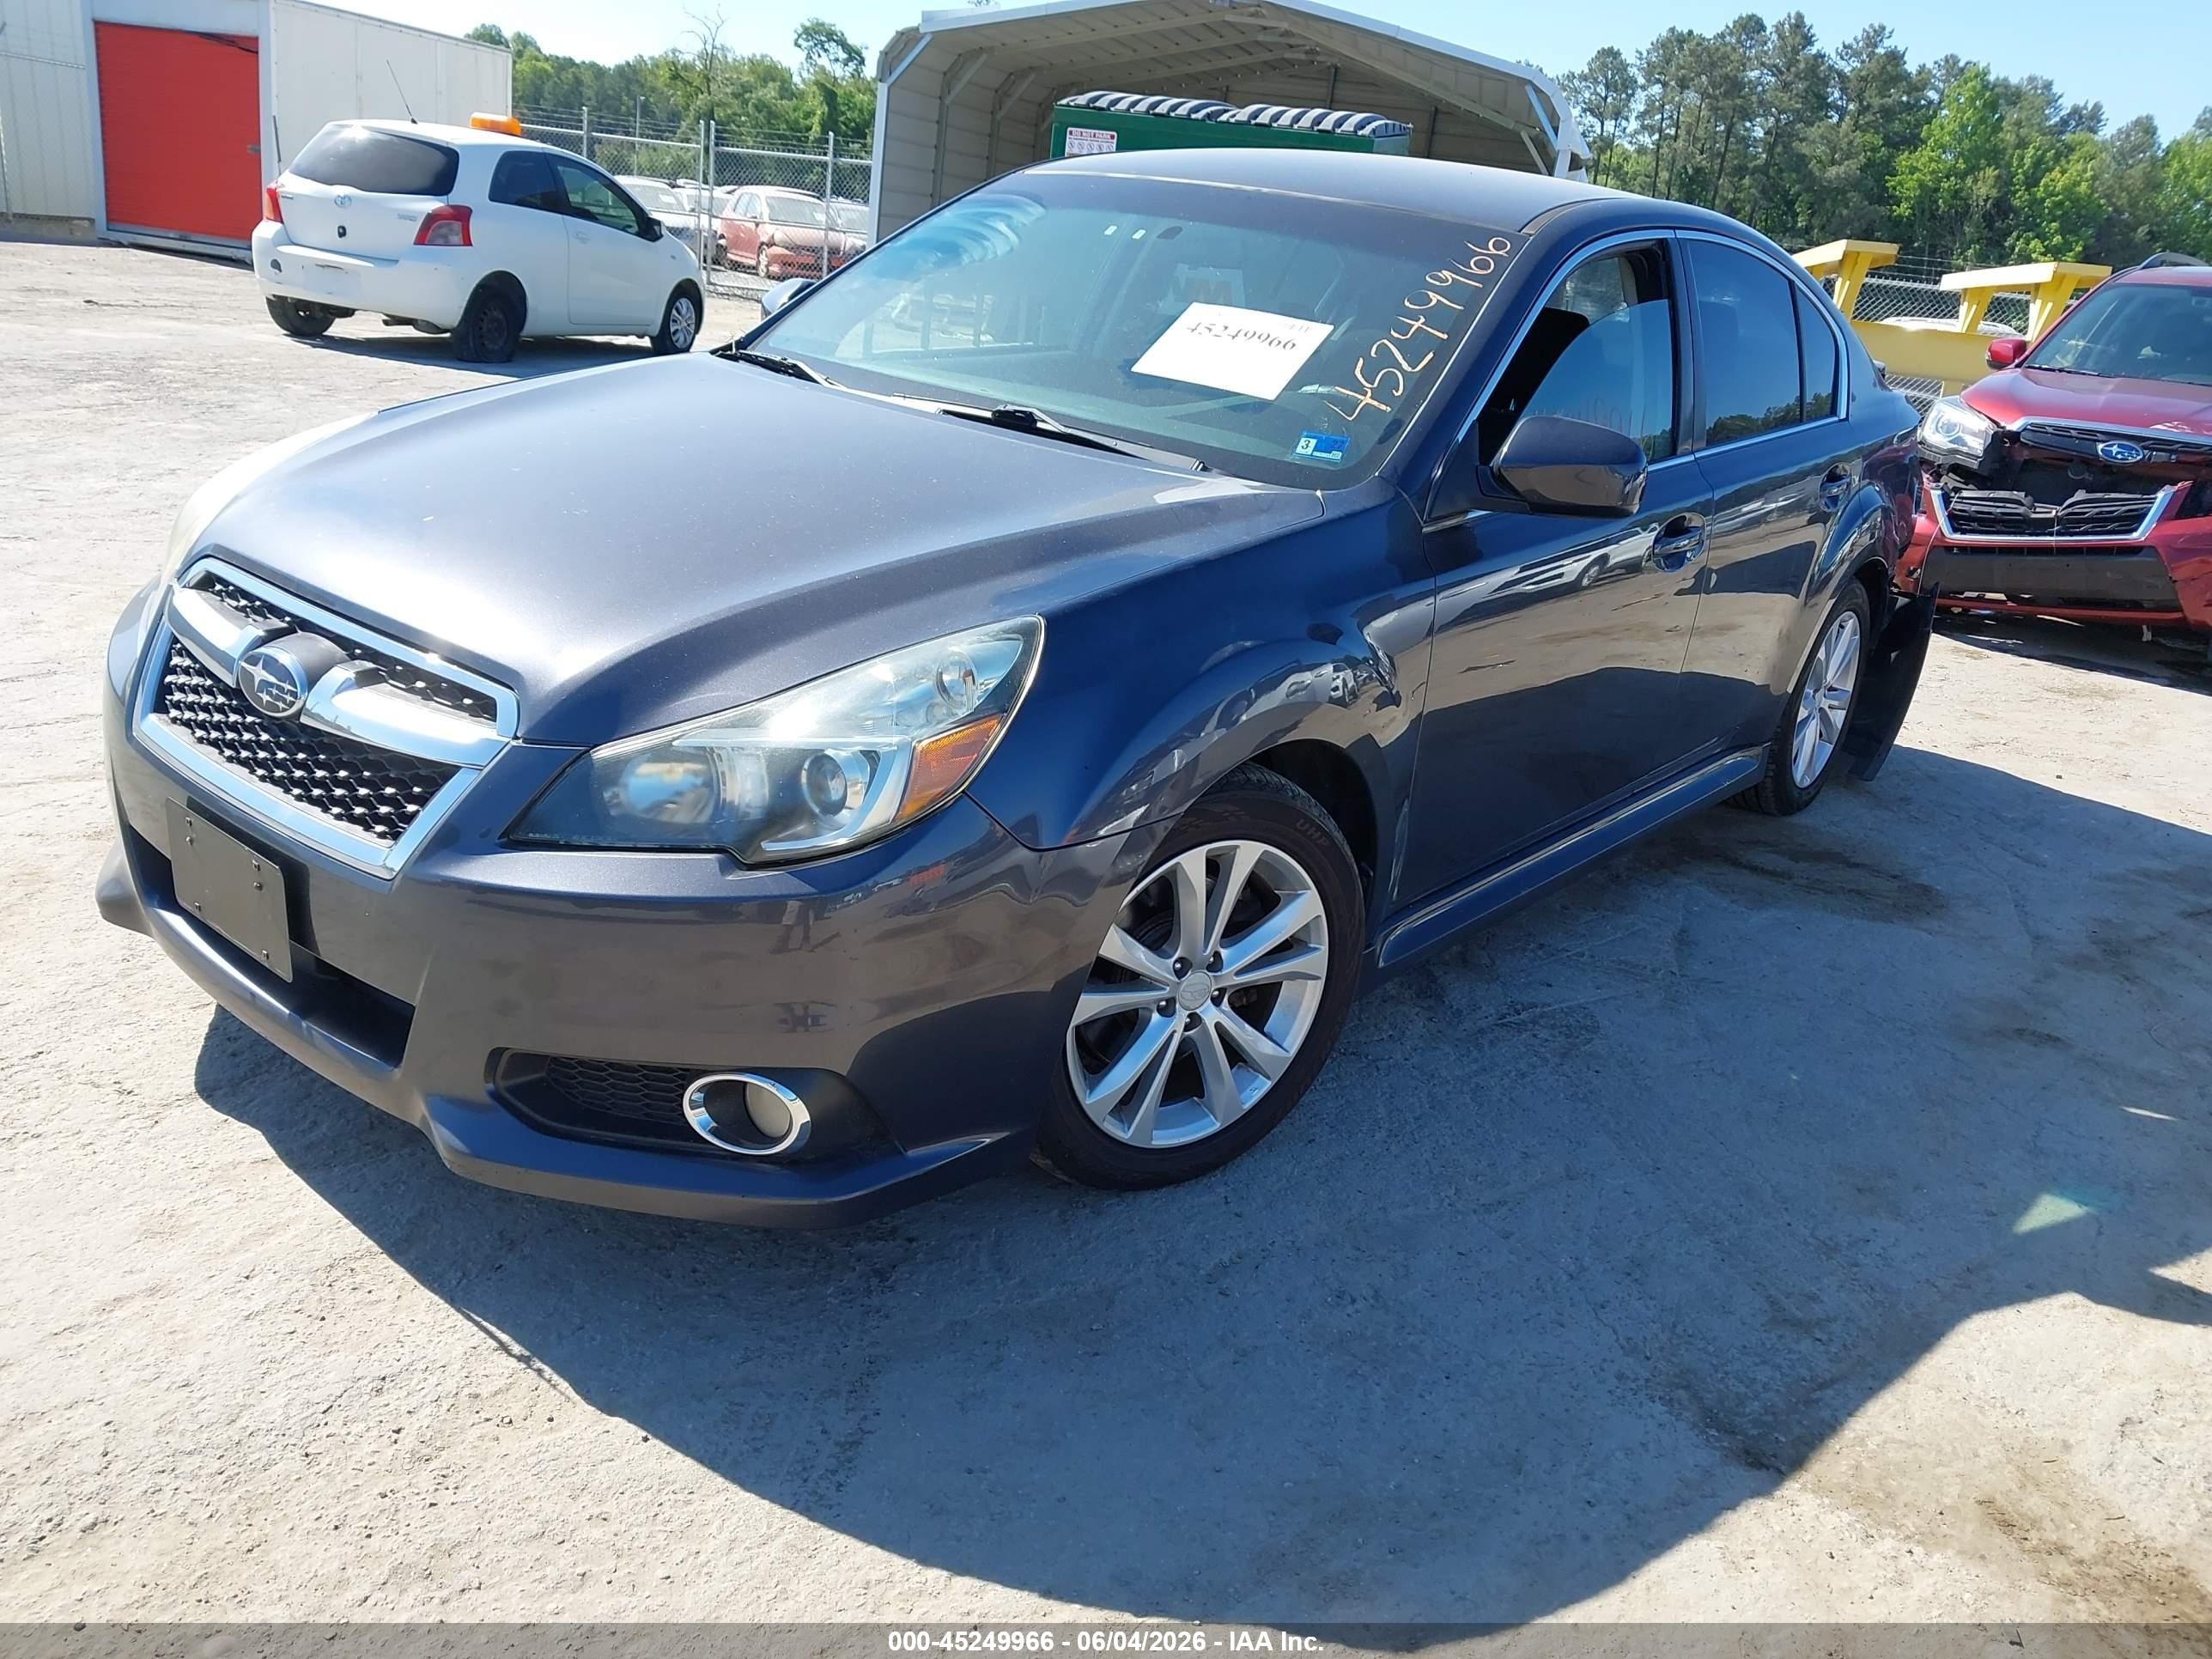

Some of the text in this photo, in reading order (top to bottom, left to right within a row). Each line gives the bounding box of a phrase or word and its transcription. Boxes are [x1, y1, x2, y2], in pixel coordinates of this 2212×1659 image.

[1186, 322, 1297, 350] 45249966
[1322, 237, 1511, 421] 45249966
[1301, 439, 1311, 449] 3
